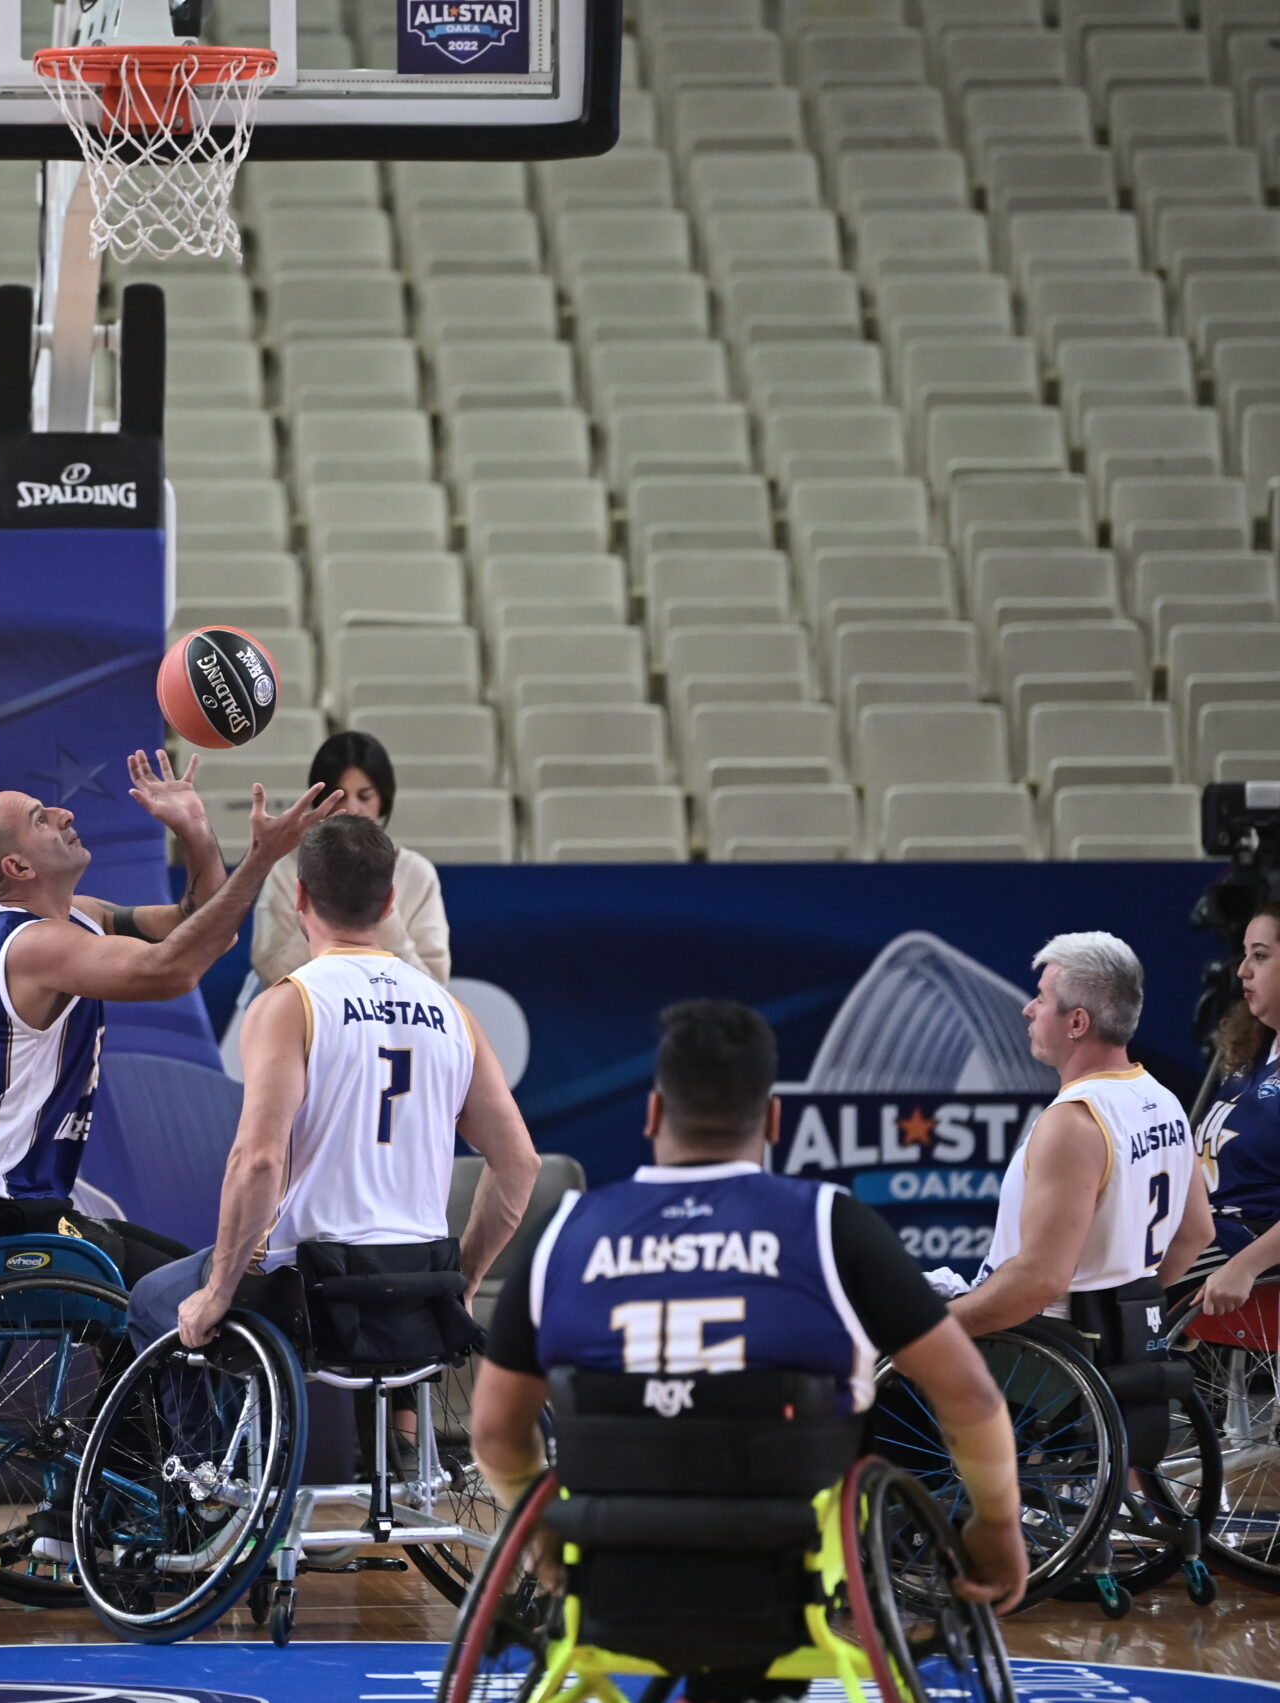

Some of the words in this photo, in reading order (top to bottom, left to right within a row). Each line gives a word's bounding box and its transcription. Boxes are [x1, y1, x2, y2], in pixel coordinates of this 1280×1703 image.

[446, 24, 481, 33] OAKA
[458, 4, 513, 26] STAR
[448, 41, 478, 51] 2022
[17, 481, 137, 509] SPALDING
[196, 650, 251, 734] SPALDING
[384, 1001, 447, 1035] STAR
[784, 1104, 921, 1175] ALL
[932, 1103, 1046, 1163] ST
[1149, 1119, 1186, 1151] STAR
[889, 1171, 1000, 1200] OAKA
[1143, 1170, 1170, 1269] 2
[582, 1235, 667, 1283] ALL
[670, 1230, 780, 1278] STAR
[899, 1226, 994, 1259] 2022
[610, 1297, 746, 1374] 15
